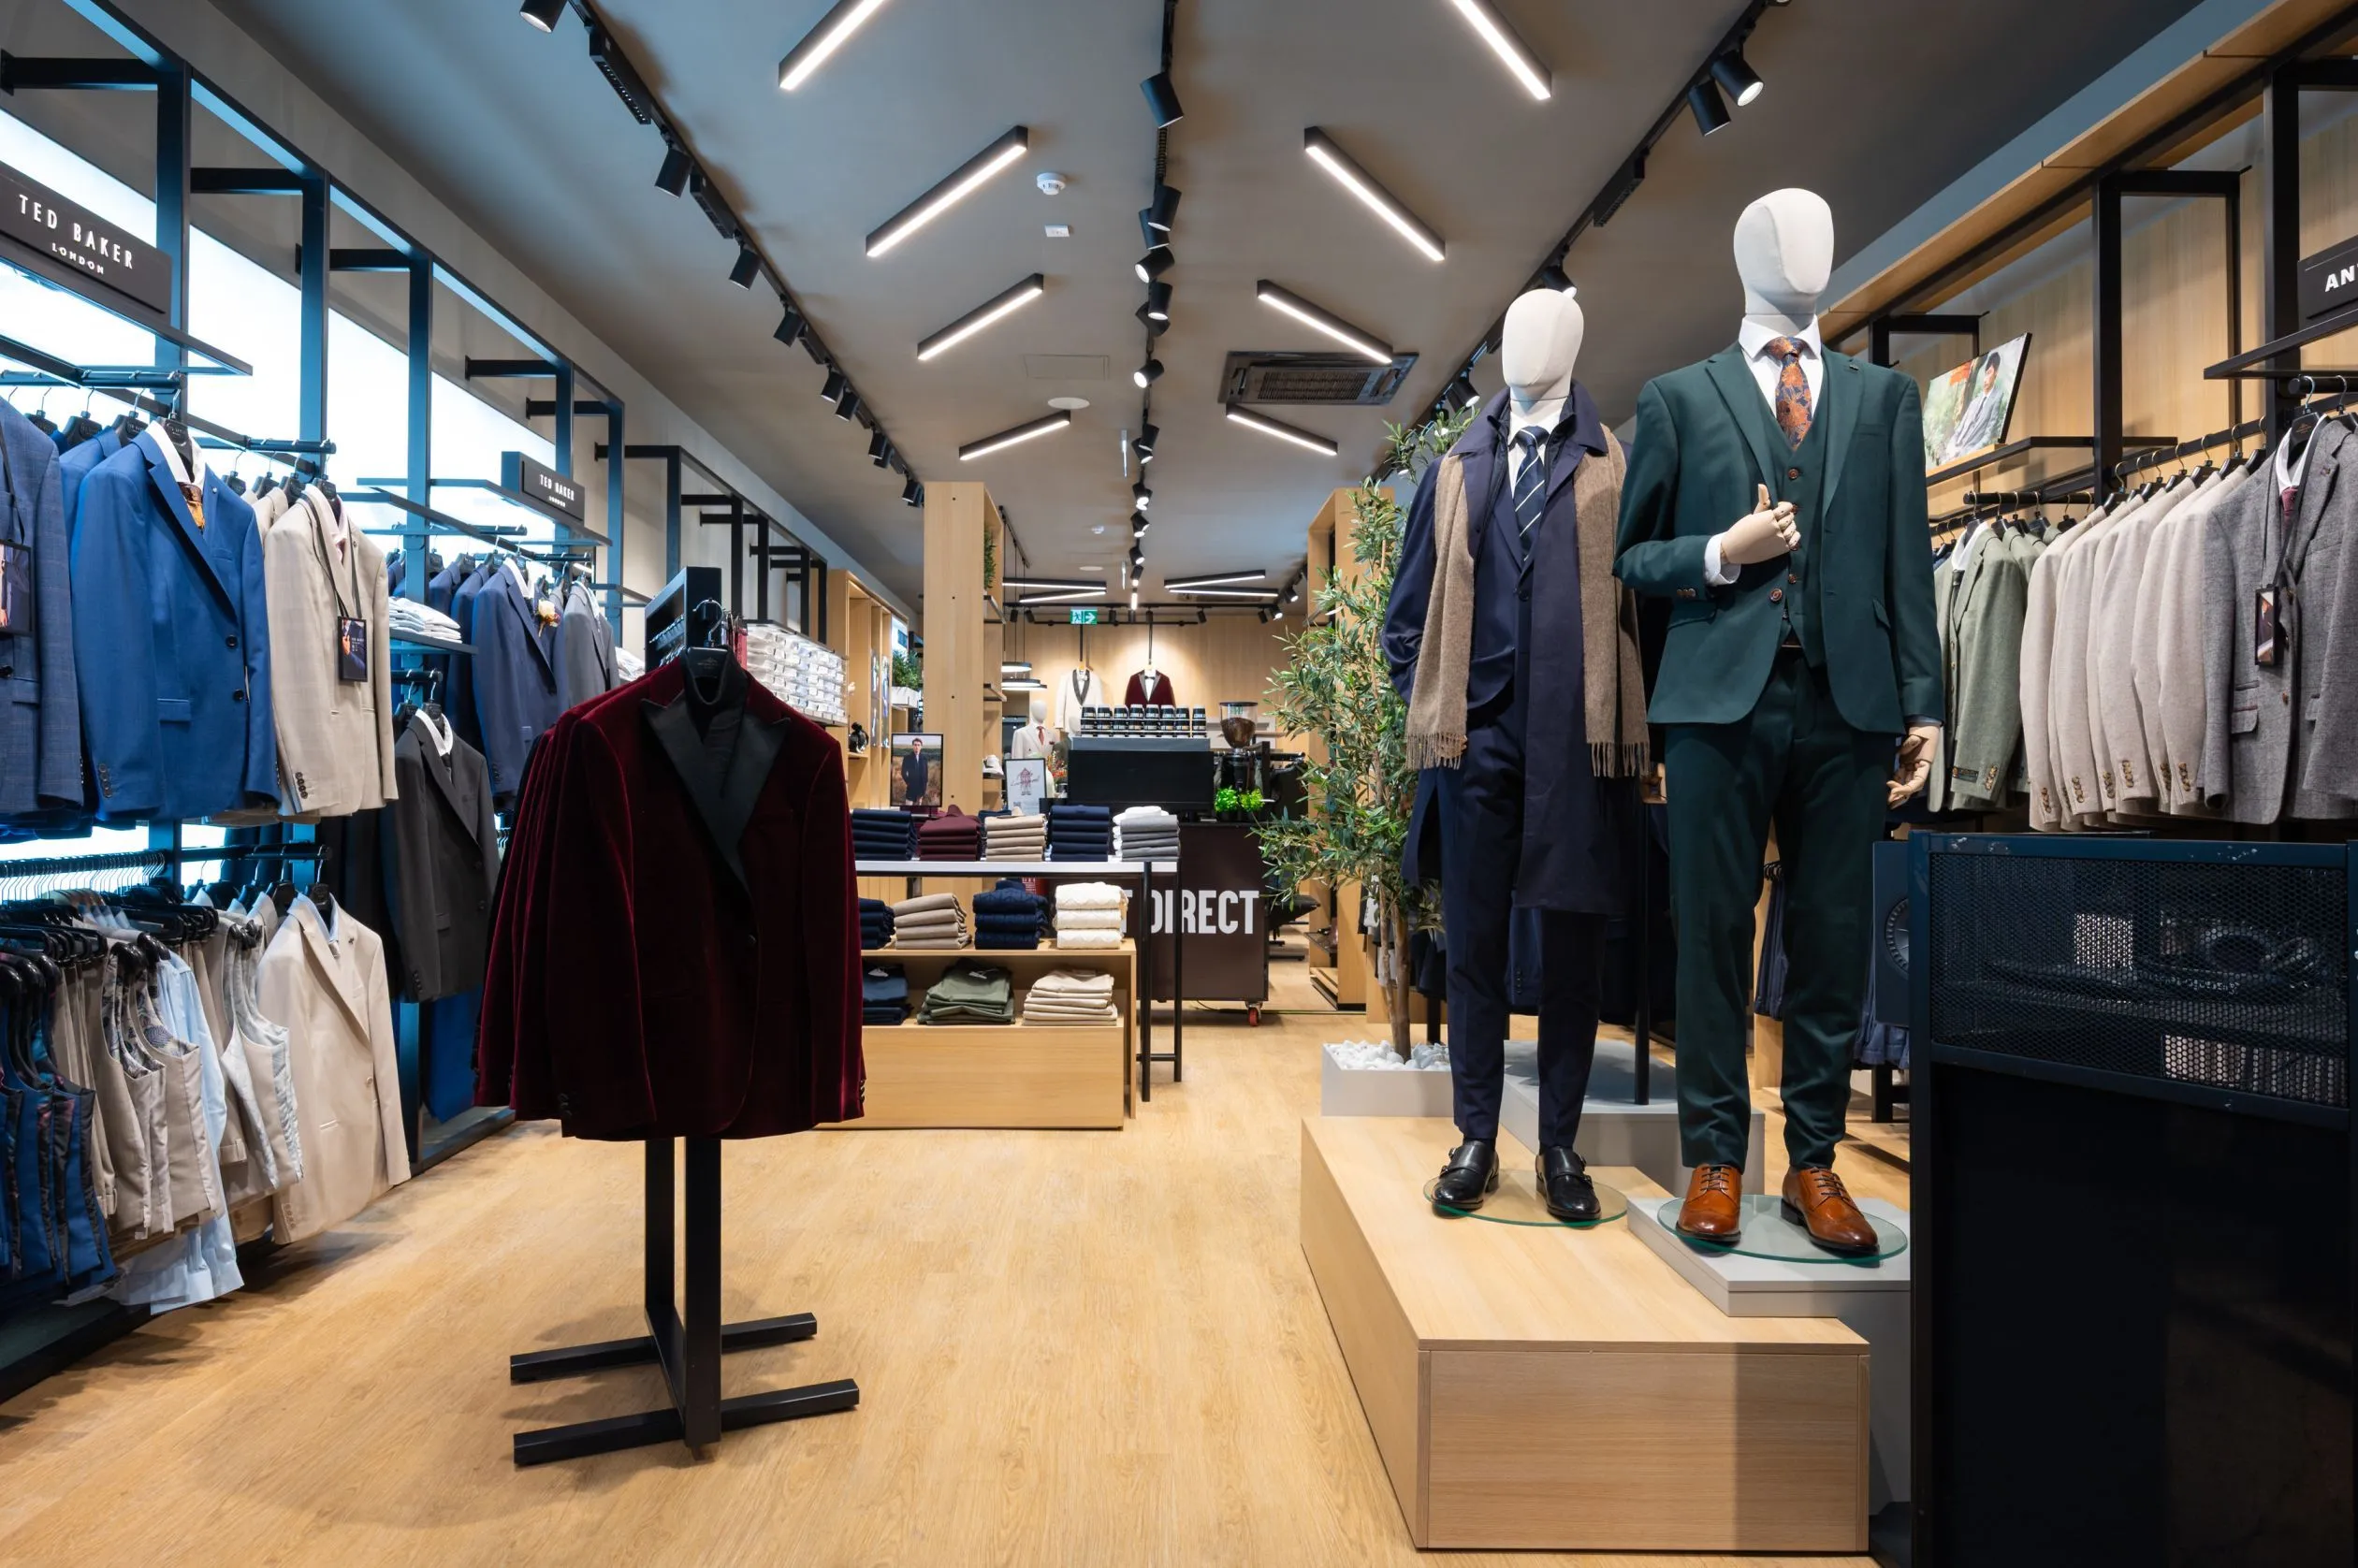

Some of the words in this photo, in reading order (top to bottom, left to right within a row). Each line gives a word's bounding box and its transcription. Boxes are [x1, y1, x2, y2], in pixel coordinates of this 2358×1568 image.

[19, 194, 58, 229] TED
[73, 223, 134, 269] BAKER
[51, 242, 105, 275] LONDON
[2324, 263, 2358, 293] AN
[539, 473, 552, 489] TED
